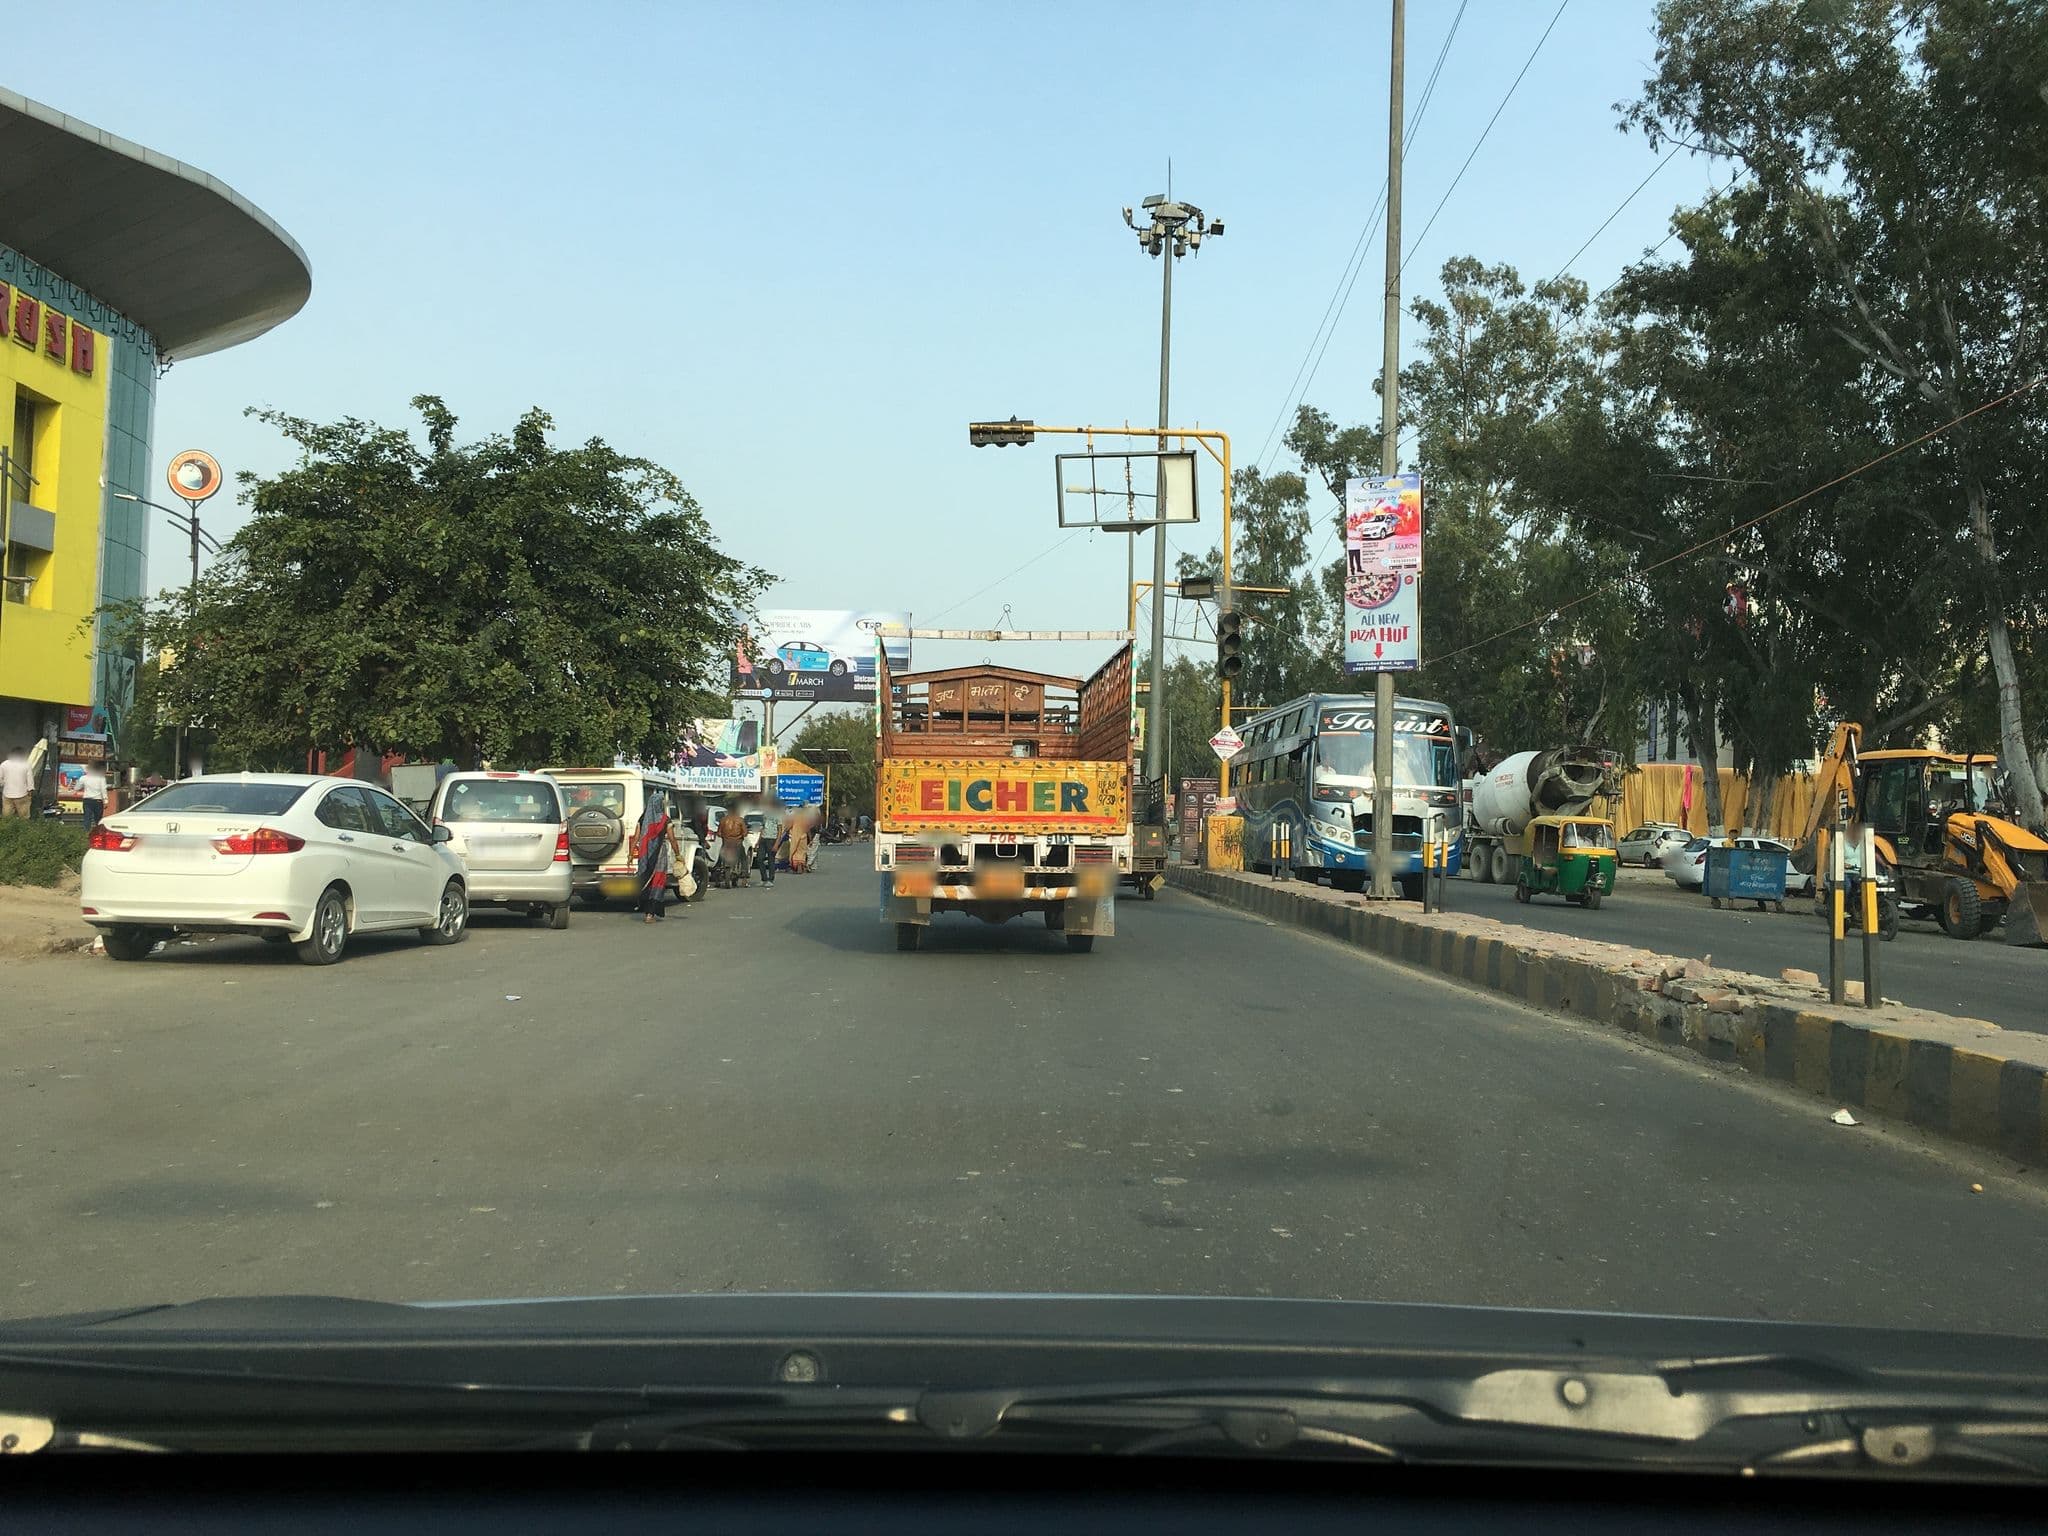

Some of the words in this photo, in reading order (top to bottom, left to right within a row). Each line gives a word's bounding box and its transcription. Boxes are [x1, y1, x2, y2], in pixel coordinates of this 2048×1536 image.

[1361, 614, 1375, 626] ALL
[1378, 613, 1399, 626] NEW
[1350, 628, 1377, 643] PIZZA
[1379, 625, 1410, 643] HUT
[796, 677, 824, 686] MARCH
[970, 685, 1003, 697] माता
[700, 767, 755, 778] ANDREWS
[720, 777, 745, 785] SCHOOL
[920, 779, 1090, 813] EICHER
[989, 833, 1017, 844] FOR
[1046, 833, 1074, 844] SIDE
[1960, 831, 1976, 845] JCB
